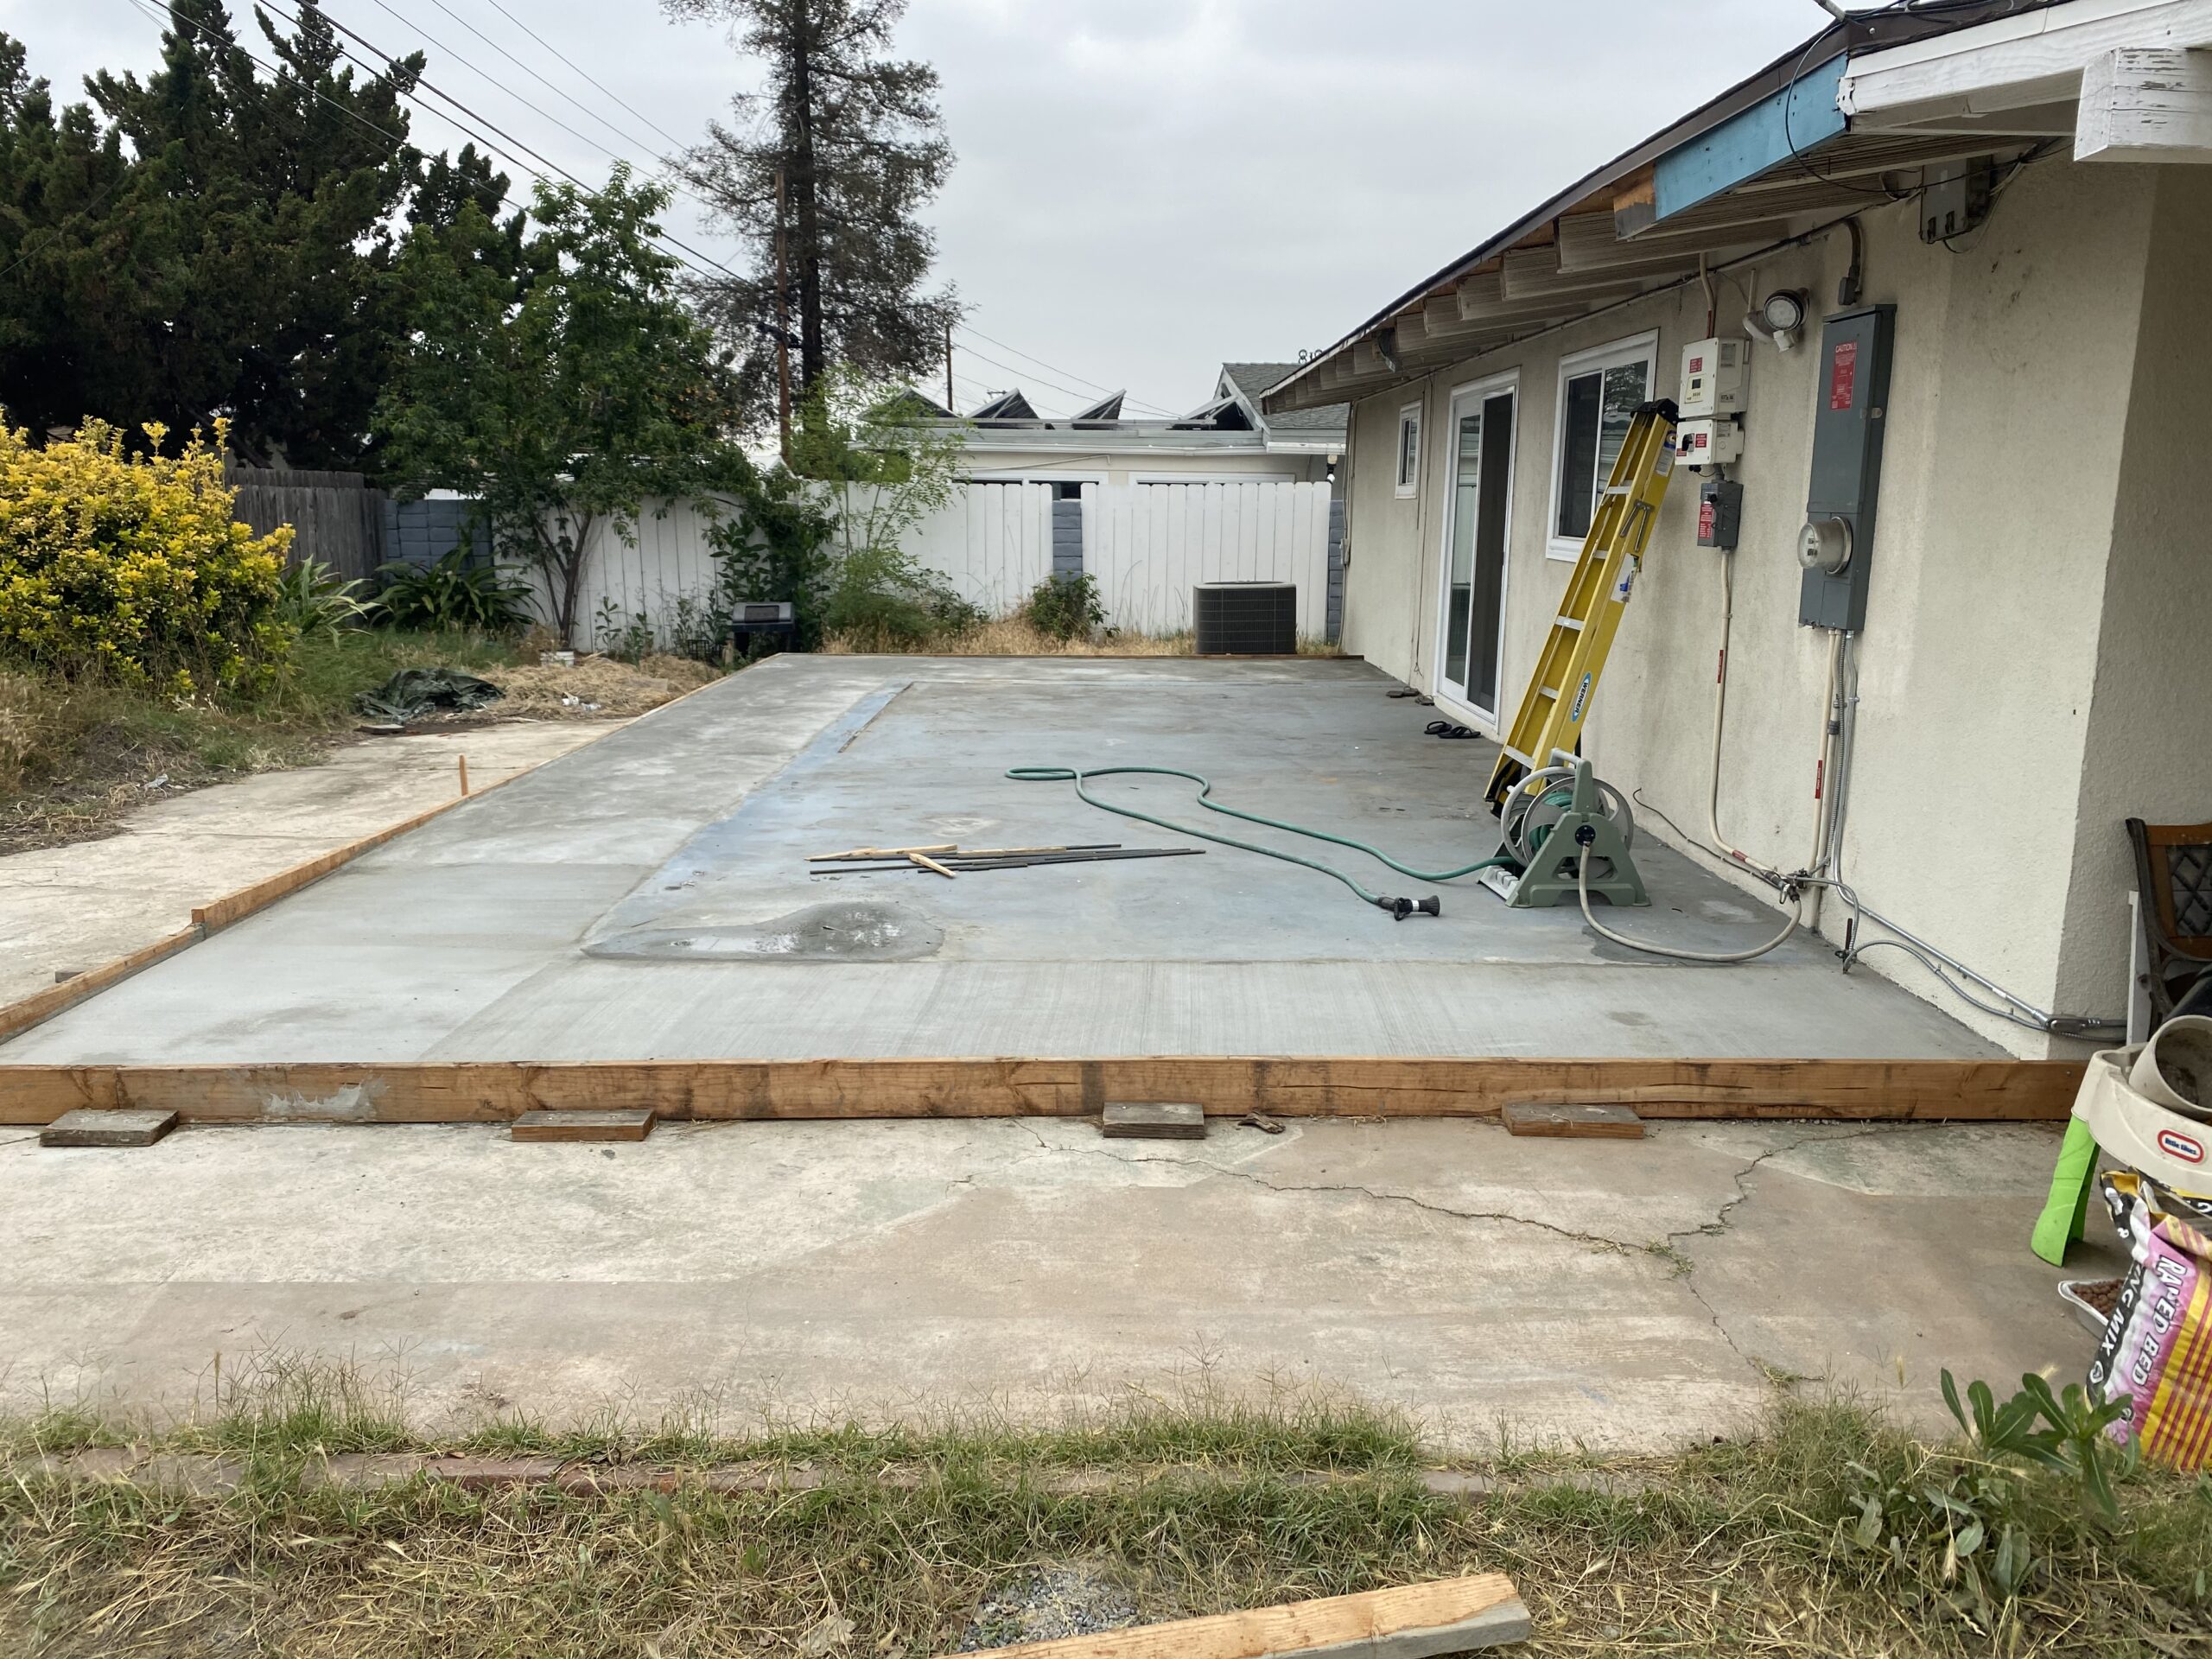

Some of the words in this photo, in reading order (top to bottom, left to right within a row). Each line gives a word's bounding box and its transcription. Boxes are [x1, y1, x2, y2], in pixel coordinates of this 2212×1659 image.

[1574, 682, 1589, 714] WERNER
[2101, 1308, 2125, 1357] MIX
[2131, 1332, 2160, 1387] BED
